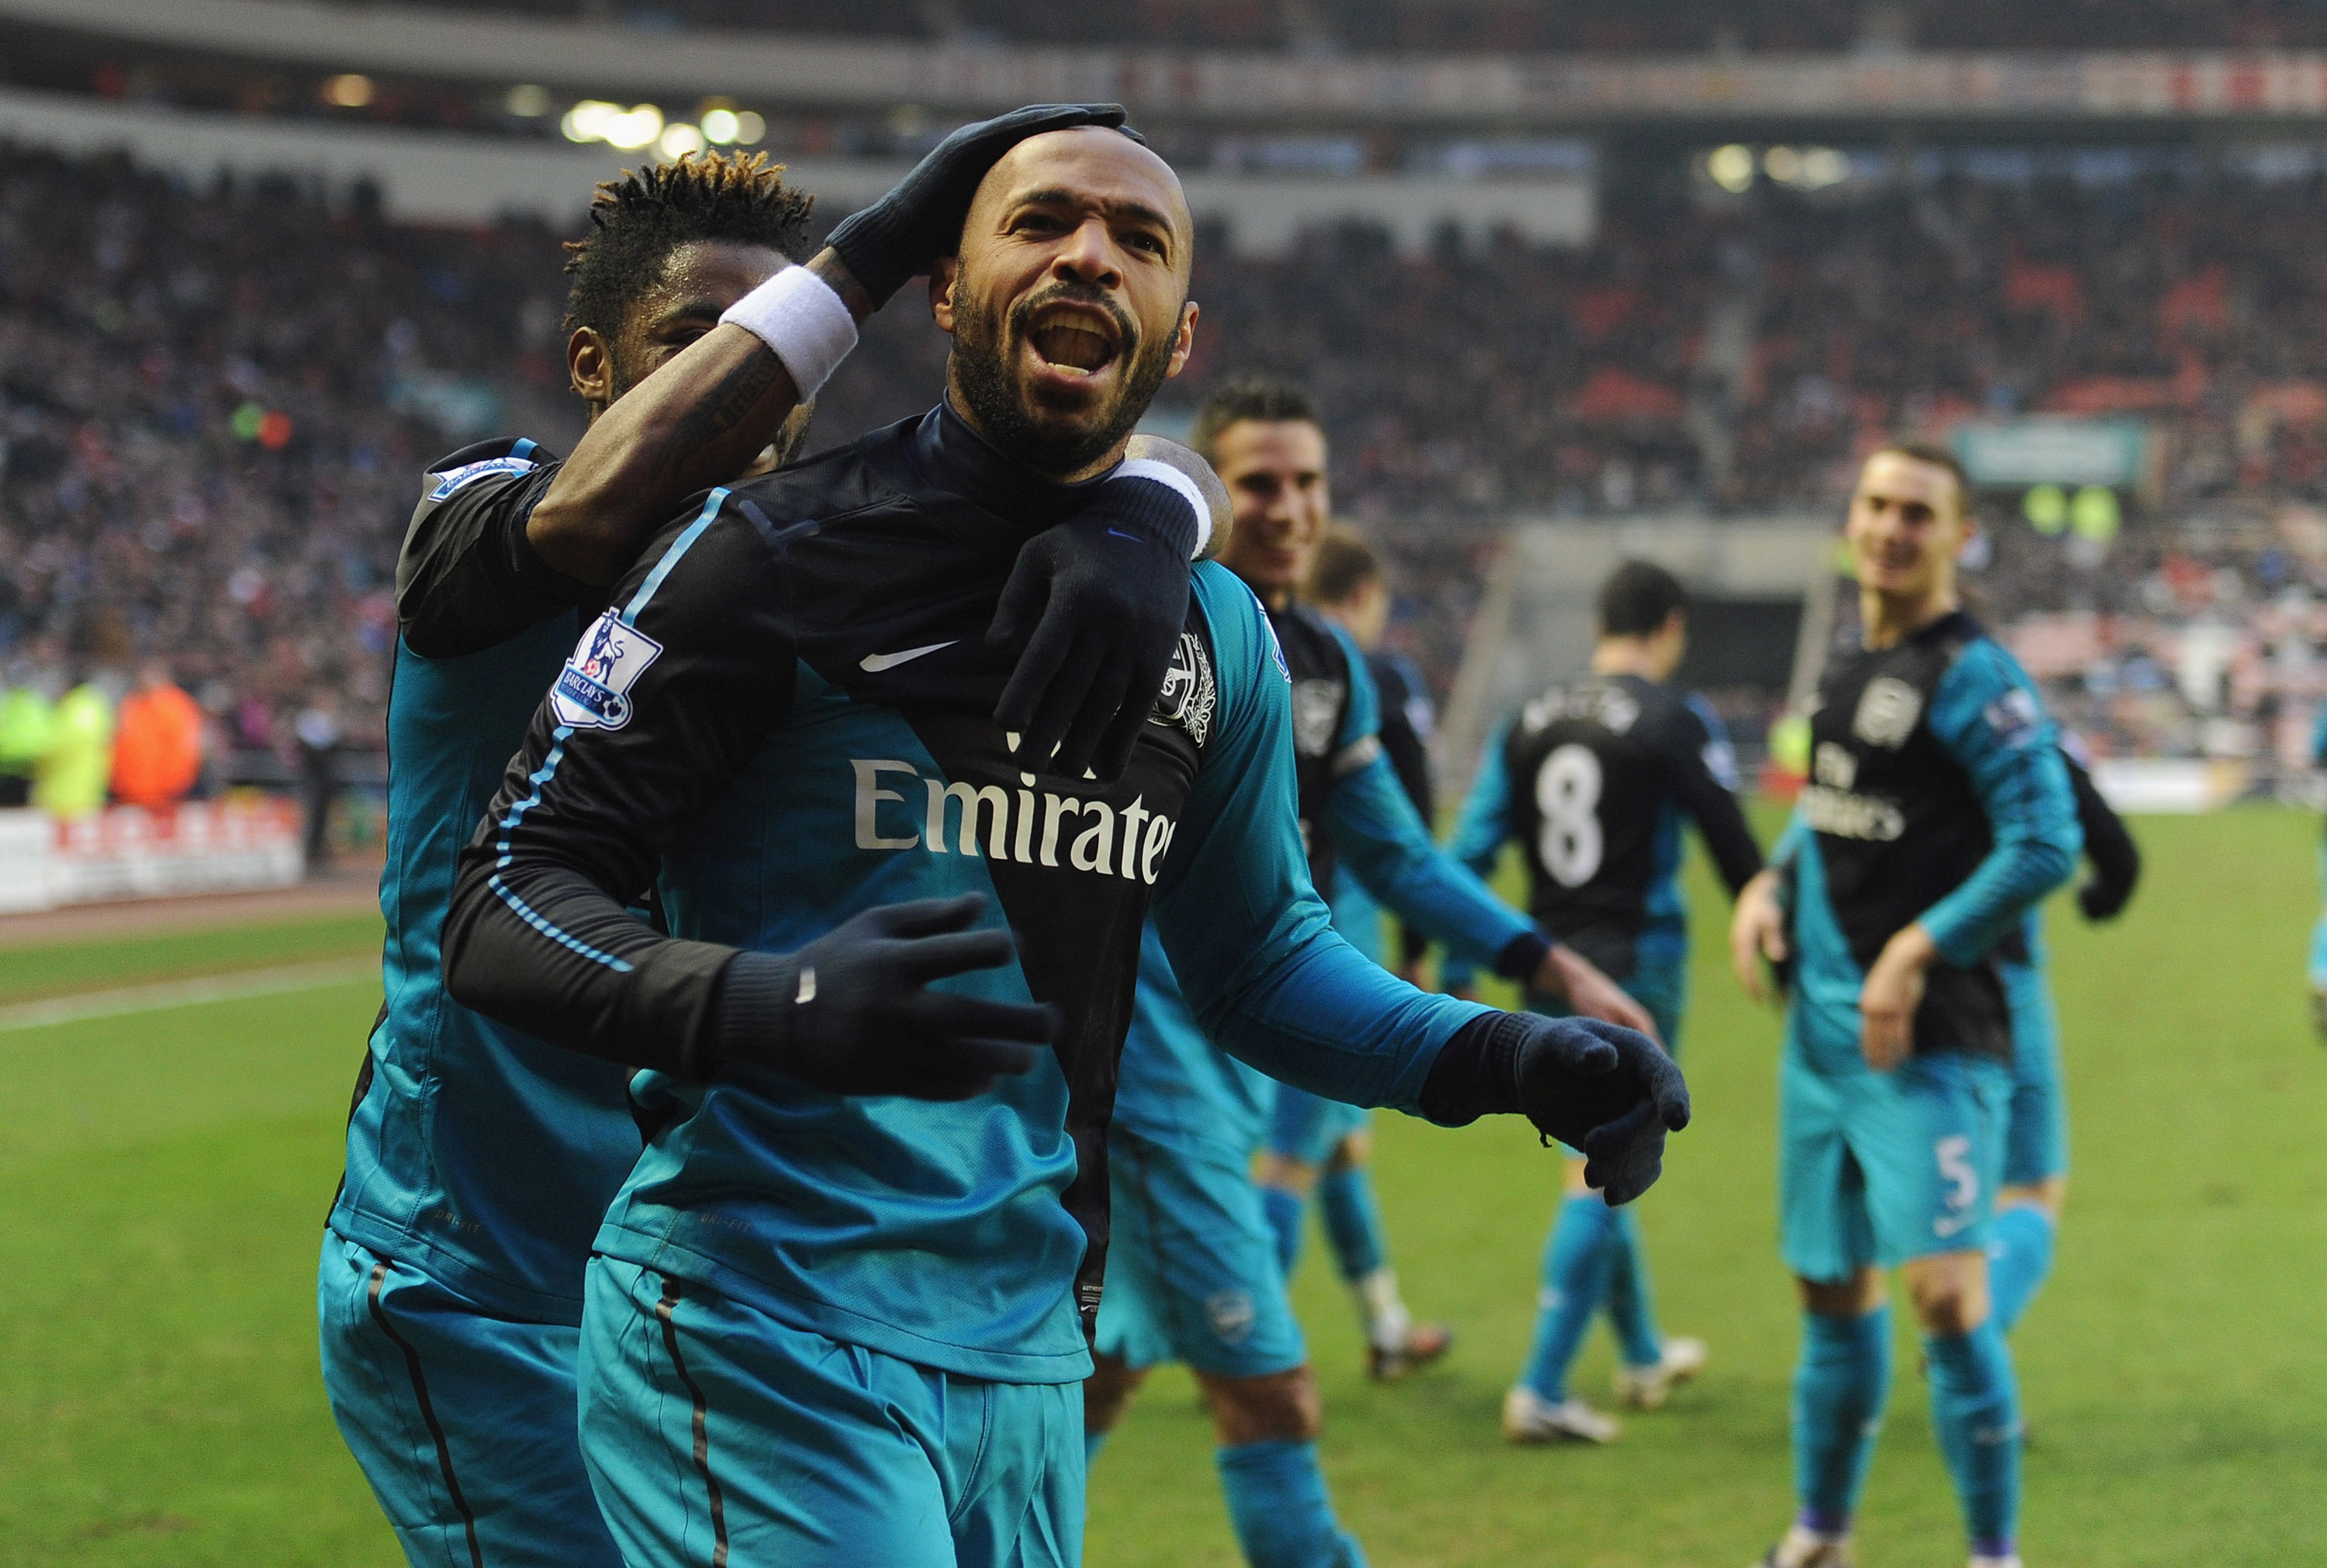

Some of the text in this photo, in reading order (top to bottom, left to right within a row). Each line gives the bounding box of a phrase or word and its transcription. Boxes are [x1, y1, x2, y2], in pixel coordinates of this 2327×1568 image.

[563, 671, 605, 703] BARCLAYS
[1534, 742, 1603, 889] 8
[1937, 1135, 1978, 1207] 5
